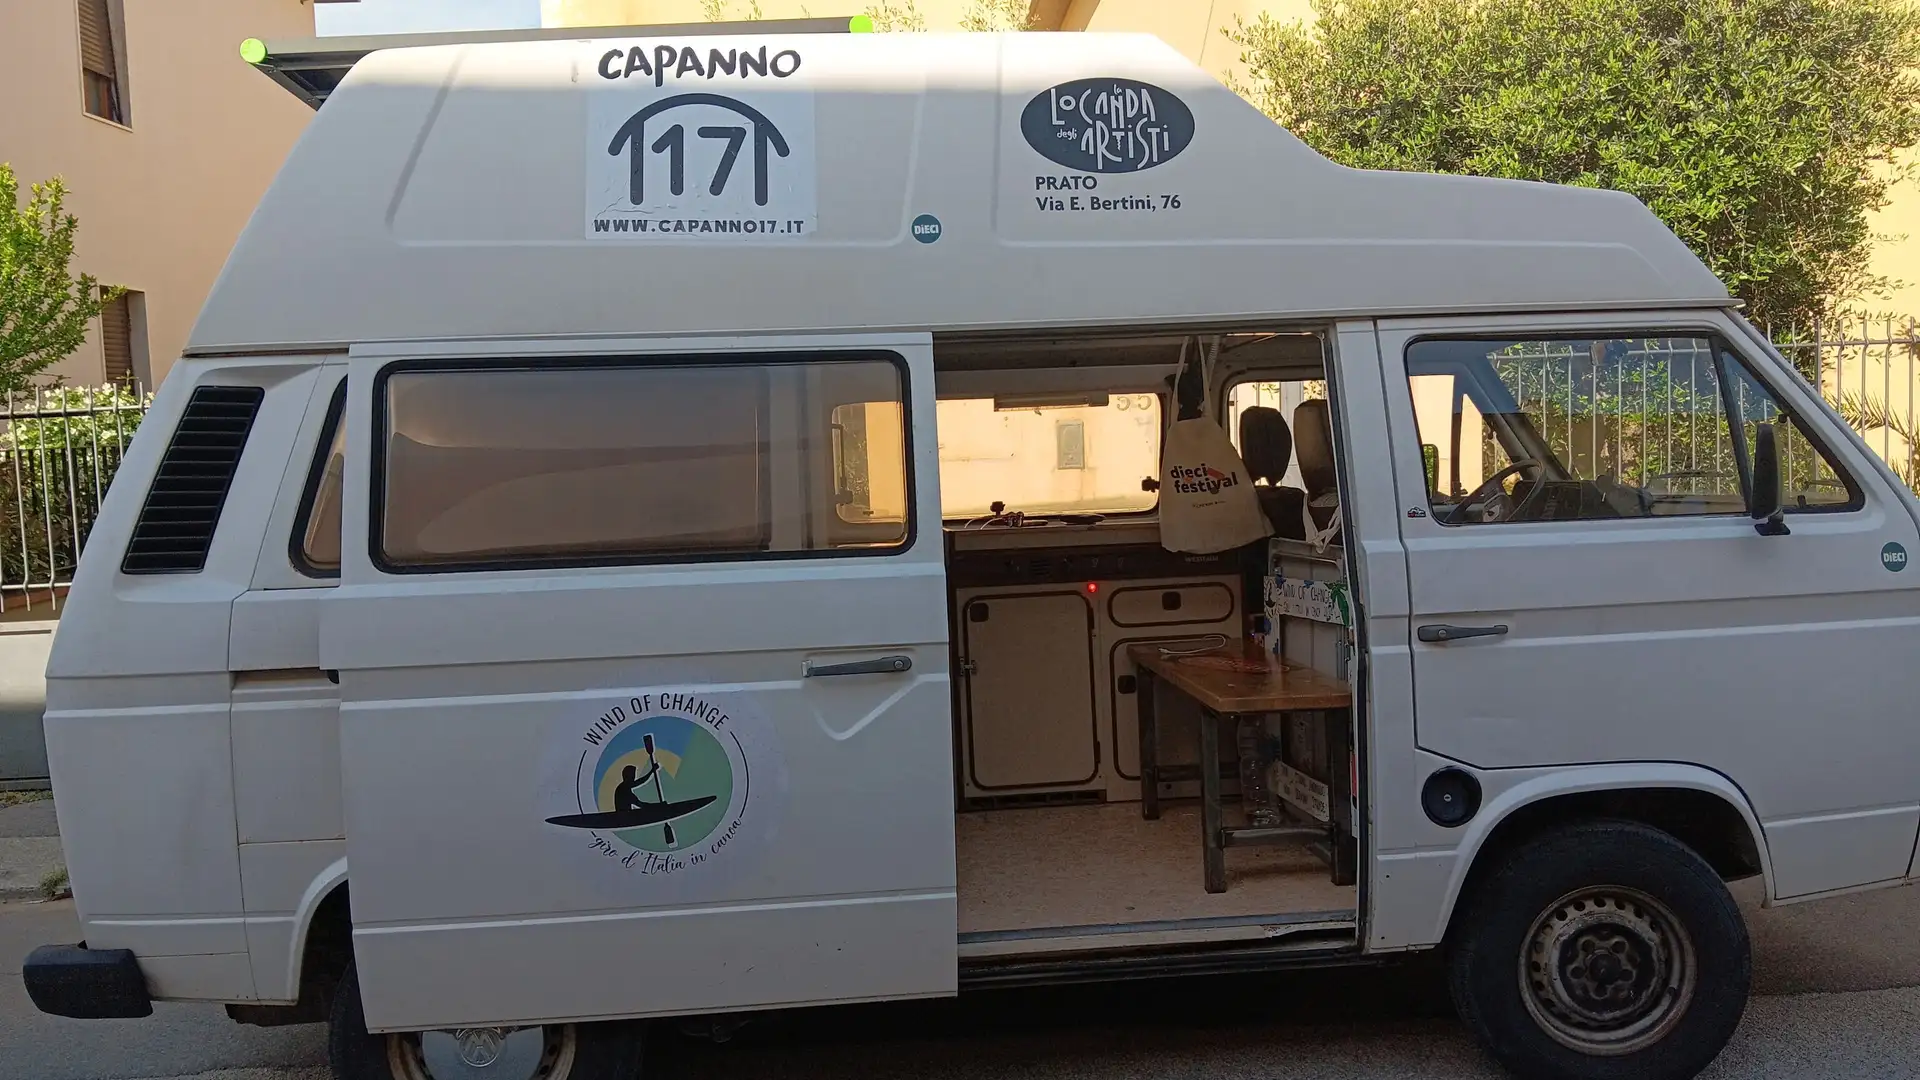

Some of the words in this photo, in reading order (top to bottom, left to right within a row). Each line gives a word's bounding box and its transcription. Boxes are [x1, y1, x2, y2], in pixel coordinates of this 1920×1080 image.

[598, 45, 801, 87] CAPANNO
[1056, 128, 1078, 141] degli
[651, 123, 747, 197] 17
[1035, 175, 1098, 190] PRATO
[1036, 196, 1065, 211] Via
[1070, 197, 1085, 211] E.
[1090, 195, 1156, 212] Bertini,
[1161, 195, 1182, 210] 76
[594, 219, 804, 233] WWW.CAPANNO17.IT
[1170, 463, 1208, 479] dieci
[1174, 472, 1239, 494] festival
[583, 706, 626, 746] WIND
[630, 694, 651, 715] OF
[660, 692, 730, 731] CHANGE
[588, 835, 619, 858] giro
[621, 850, 686, 876] d'Italia
[691, 853, 707, 864] in
[711, 818, 742, 855] canoa
